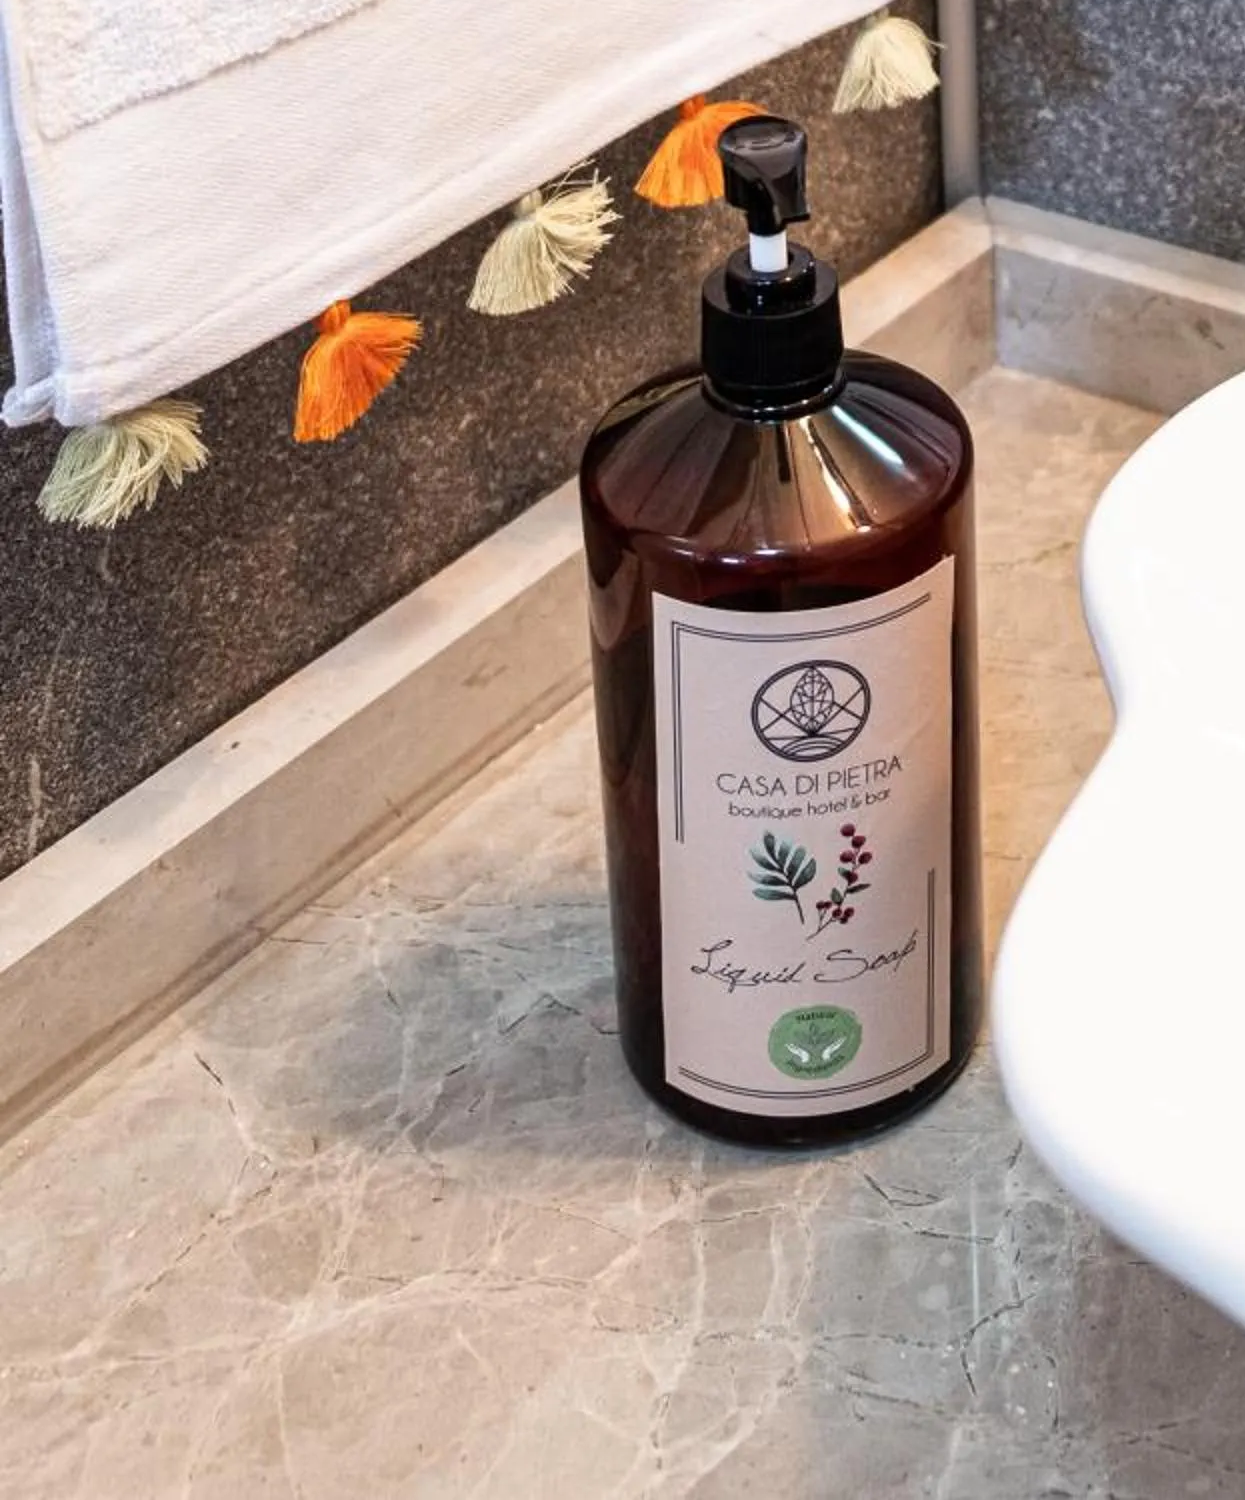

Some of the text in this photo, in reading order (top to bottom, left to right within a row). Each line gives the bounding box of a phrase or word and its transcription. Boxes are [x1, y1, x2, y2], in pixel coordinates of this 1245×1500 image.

[715, 755, 903, 797] CASA DI PIETRA
[728, 786, 891, 820] boutique hotel & bar
[691, 928, 918, 994] Liquid Soap
